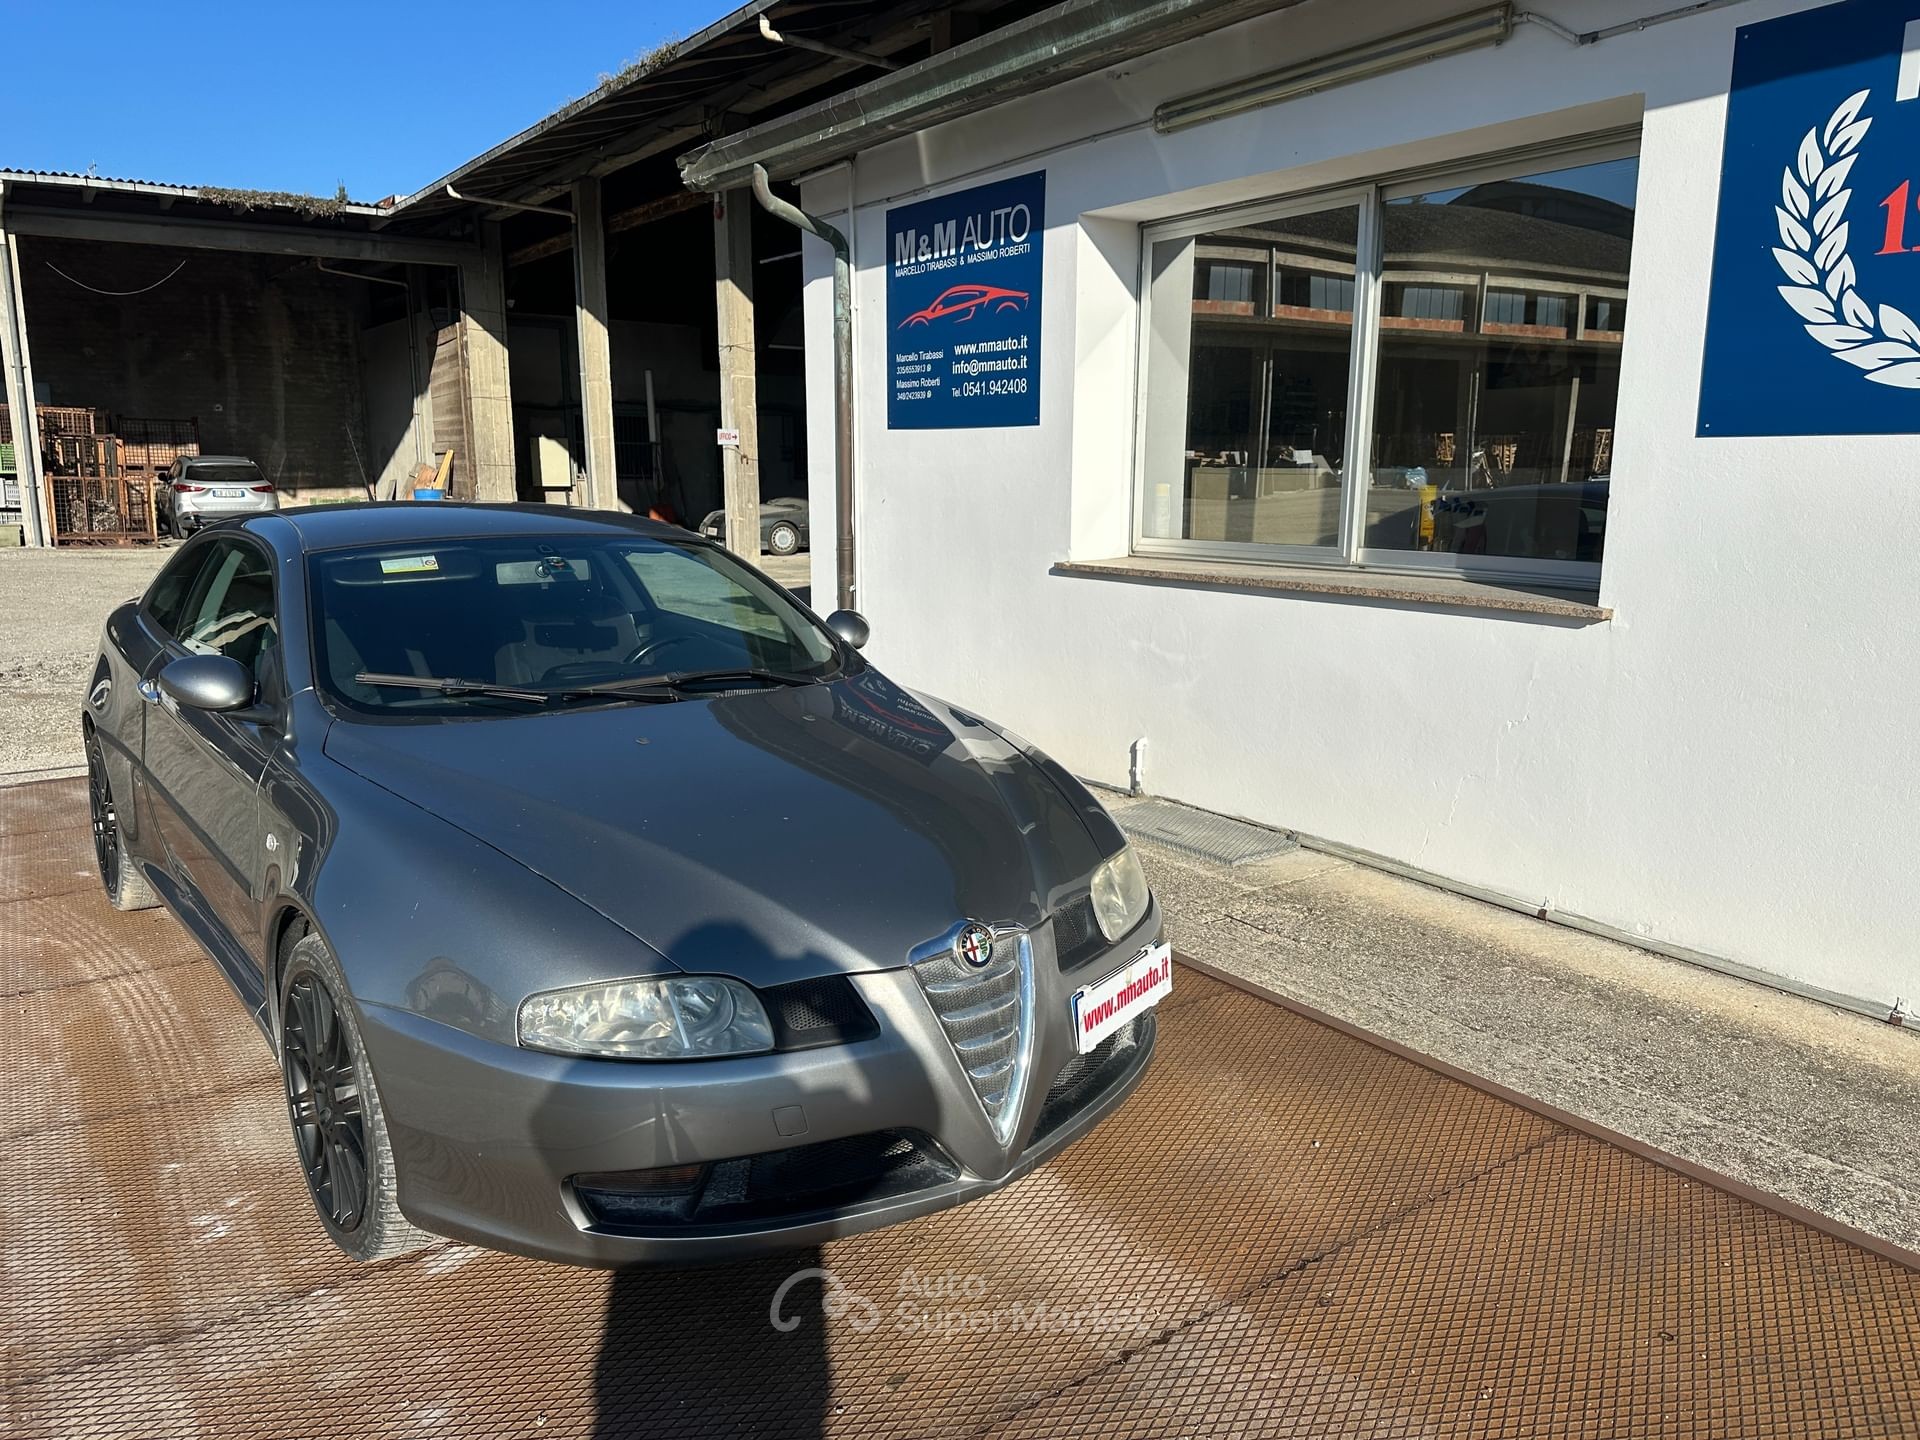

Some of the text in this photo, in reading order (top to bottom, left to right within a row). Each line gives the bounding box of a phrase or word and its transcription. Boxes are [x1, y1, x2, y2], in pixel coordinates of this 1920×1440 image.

[1874, 179, 1920, 256] 1
[895, 203, 1031, 267] M&M AUTO
[895, 243, 1031, 278] MARCELLO TIRABASSI & MASSIMO ROBERTI
[896, 348, 944, 363] Marcello Tirabassi
[954, 334, 1029, 355] www.mmauto.it
[952, 354, 1028, 376] info@mmauto.it
[896, 376, 941, 389] Massimo Roberti
[951, 377, 1028, 397] Tel. 0541.942408
[1084, 956, 1169, 1034] www.mmauto.it
